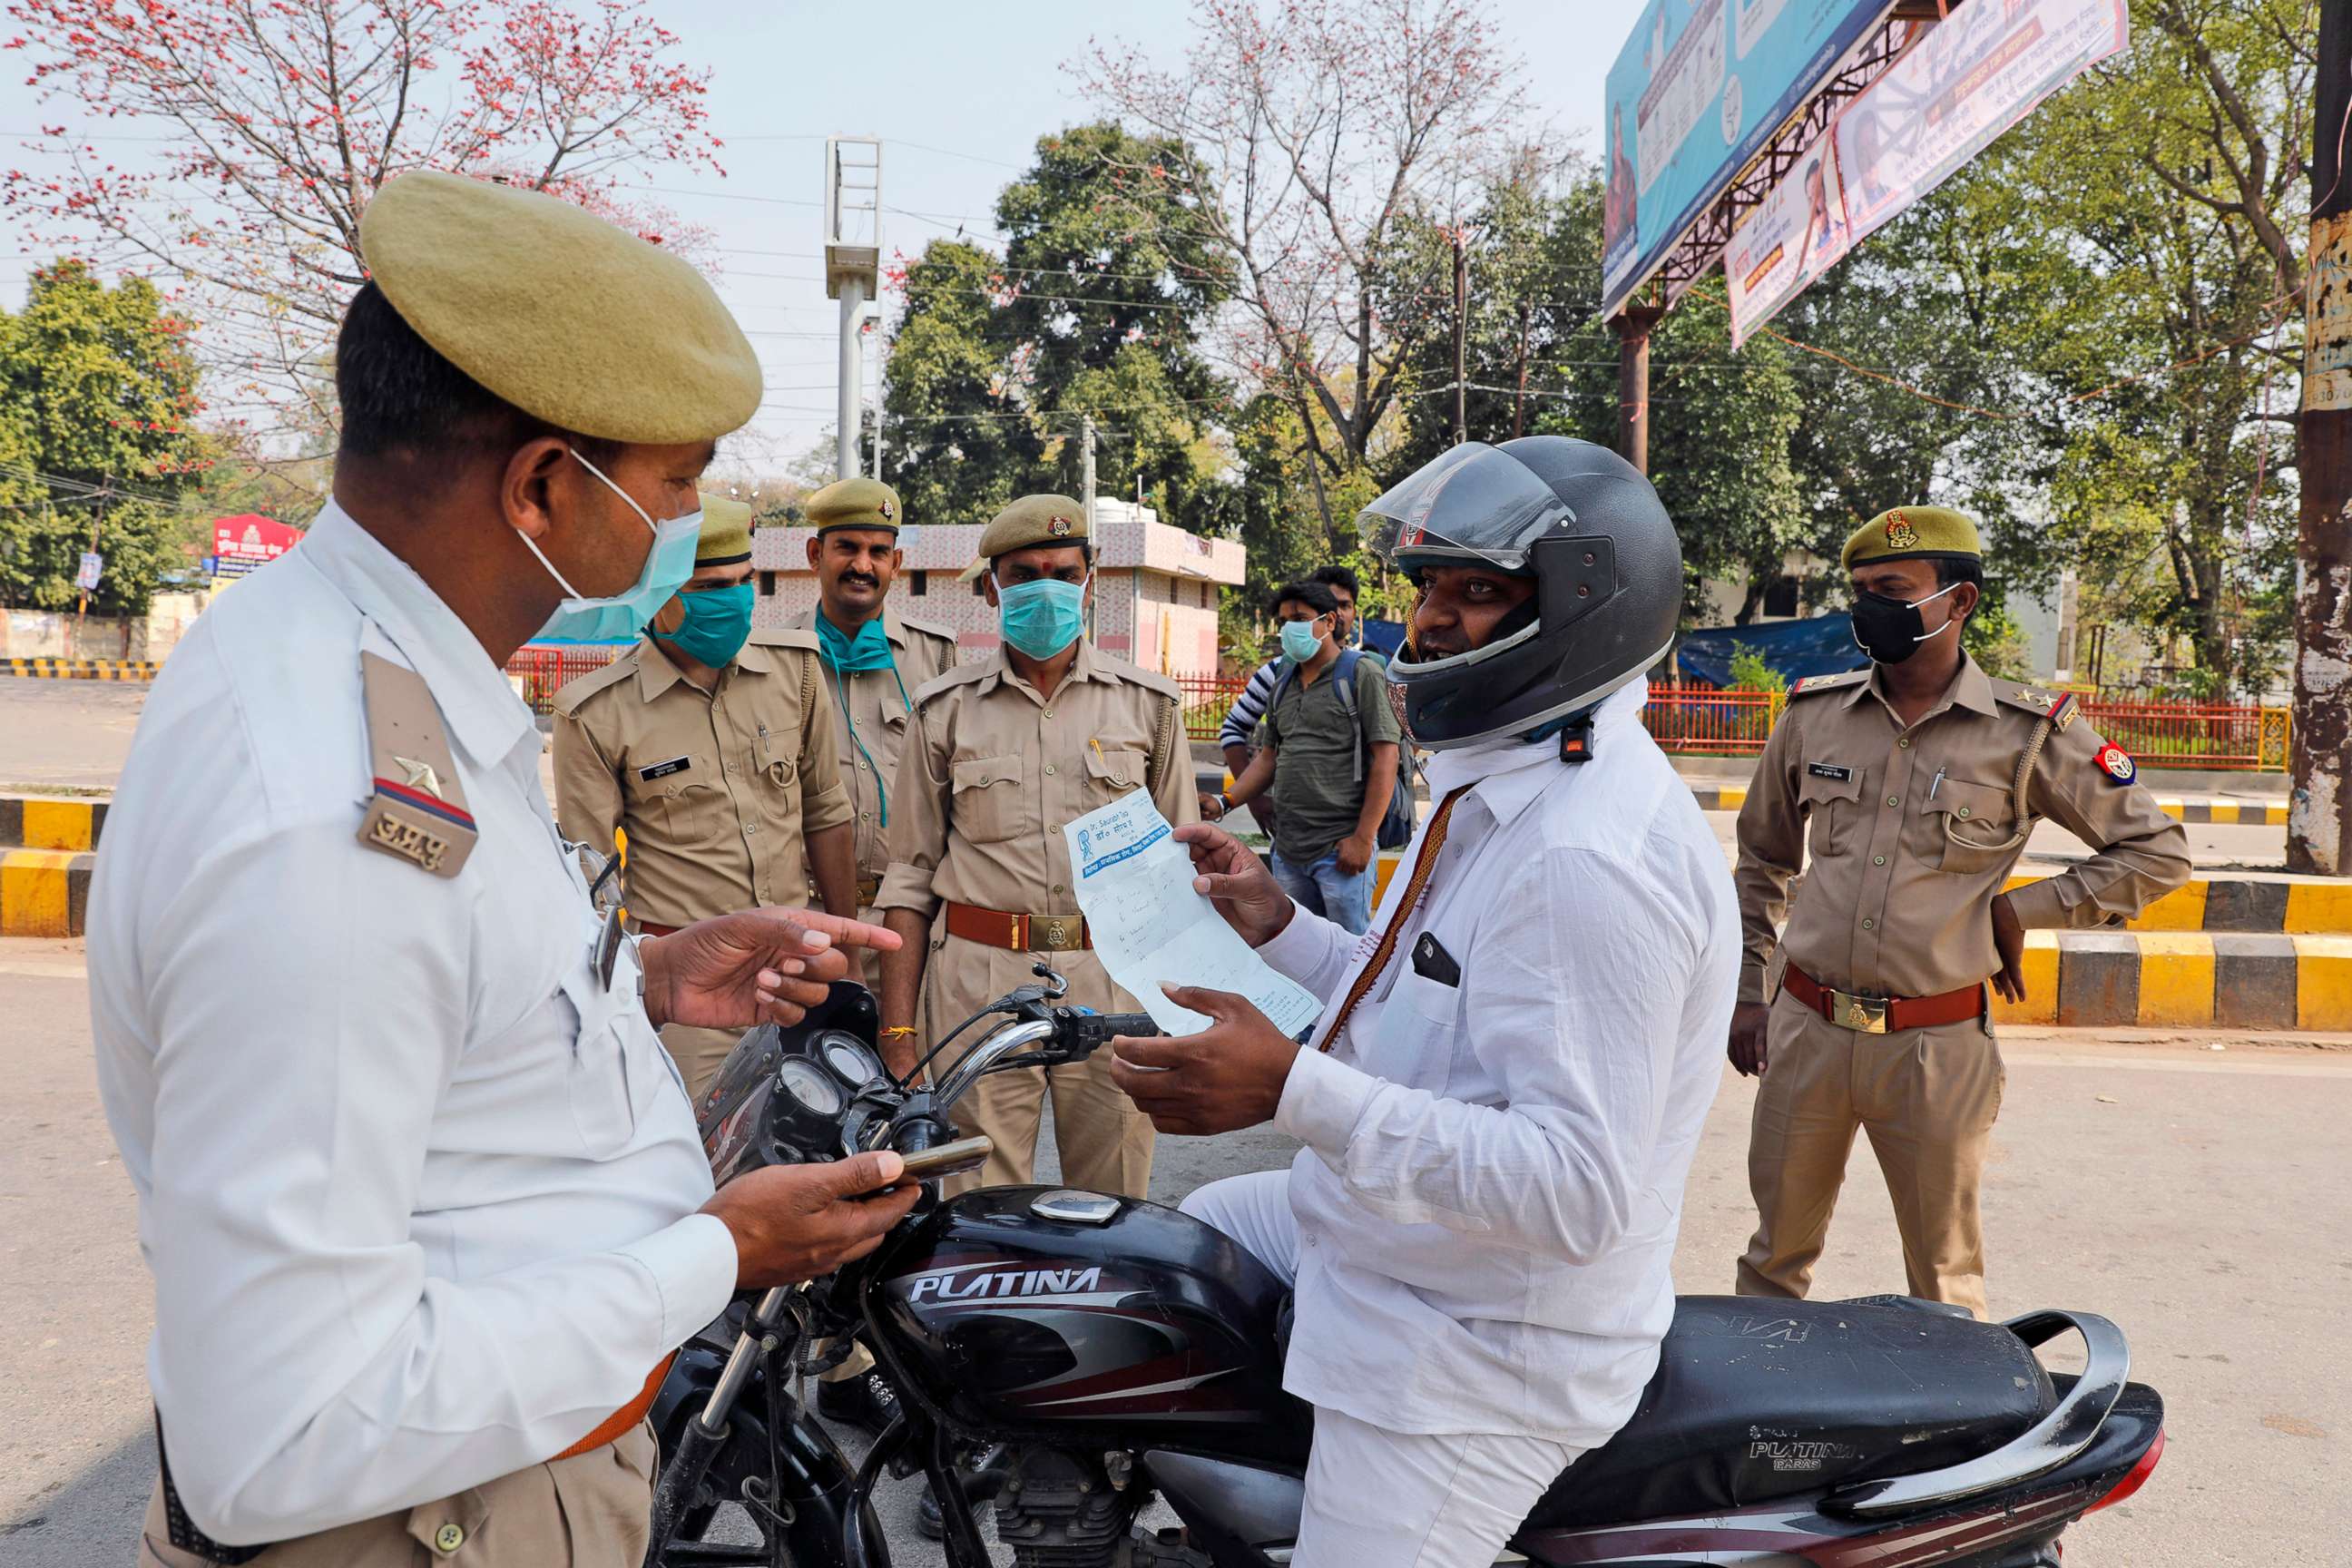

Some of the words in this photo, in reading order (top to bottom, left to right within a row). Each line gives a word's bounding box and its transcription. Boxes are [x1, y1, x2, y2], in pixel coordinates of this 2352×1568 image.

[908, 1267, 1102, 1303] PLATINA
[1749, 1442, 1857, 1458] PLATINA
[1774, 1459, 1822, 1471] PARAS
